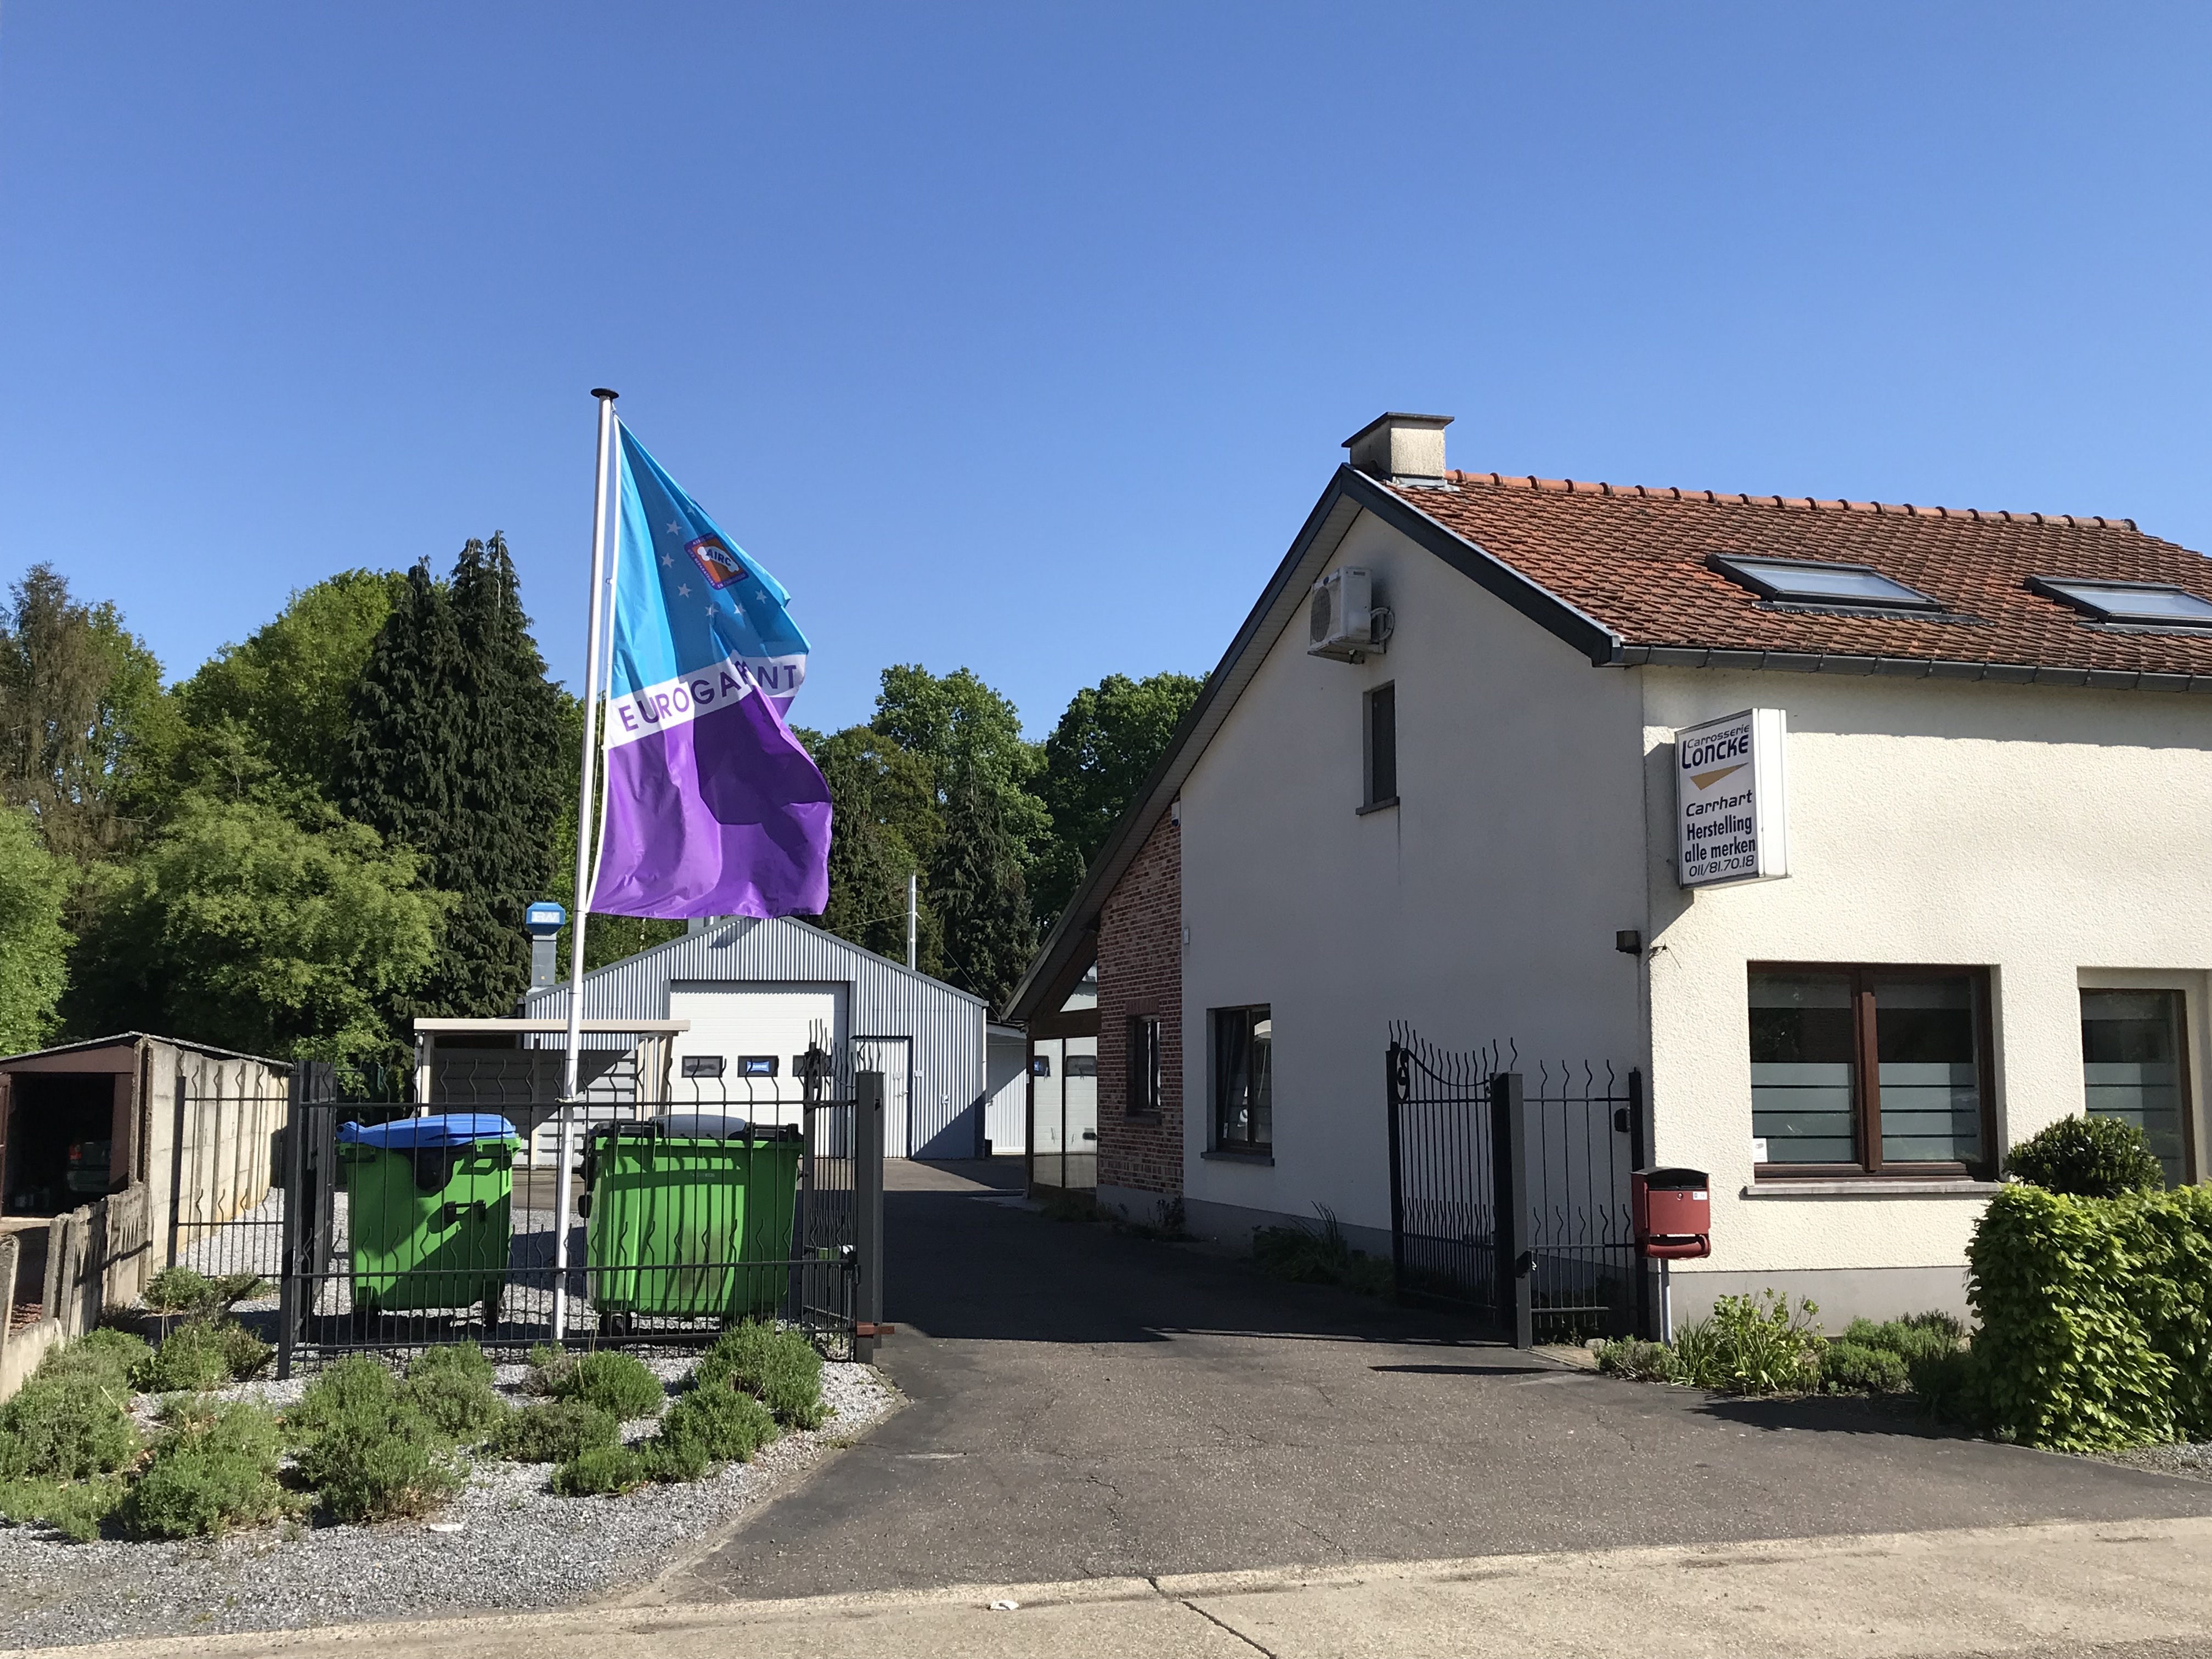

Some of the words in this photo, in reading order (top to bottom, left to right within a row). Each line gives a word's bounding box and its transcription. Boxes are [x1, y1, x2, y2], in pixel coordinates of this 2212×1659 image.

[706, 549, 731, 566] AIRC
[1688, 724, 1750, 748] Carrosserie
[1686, 789, 1753, 817] Carrhart
[1687, 814, 1752, 840] Herstelling
[1685, 843, 1707, 863] alle
[1711, 836, 1756, 859] merken
[1689, 855, 1754, 877] 011/81.70.18
